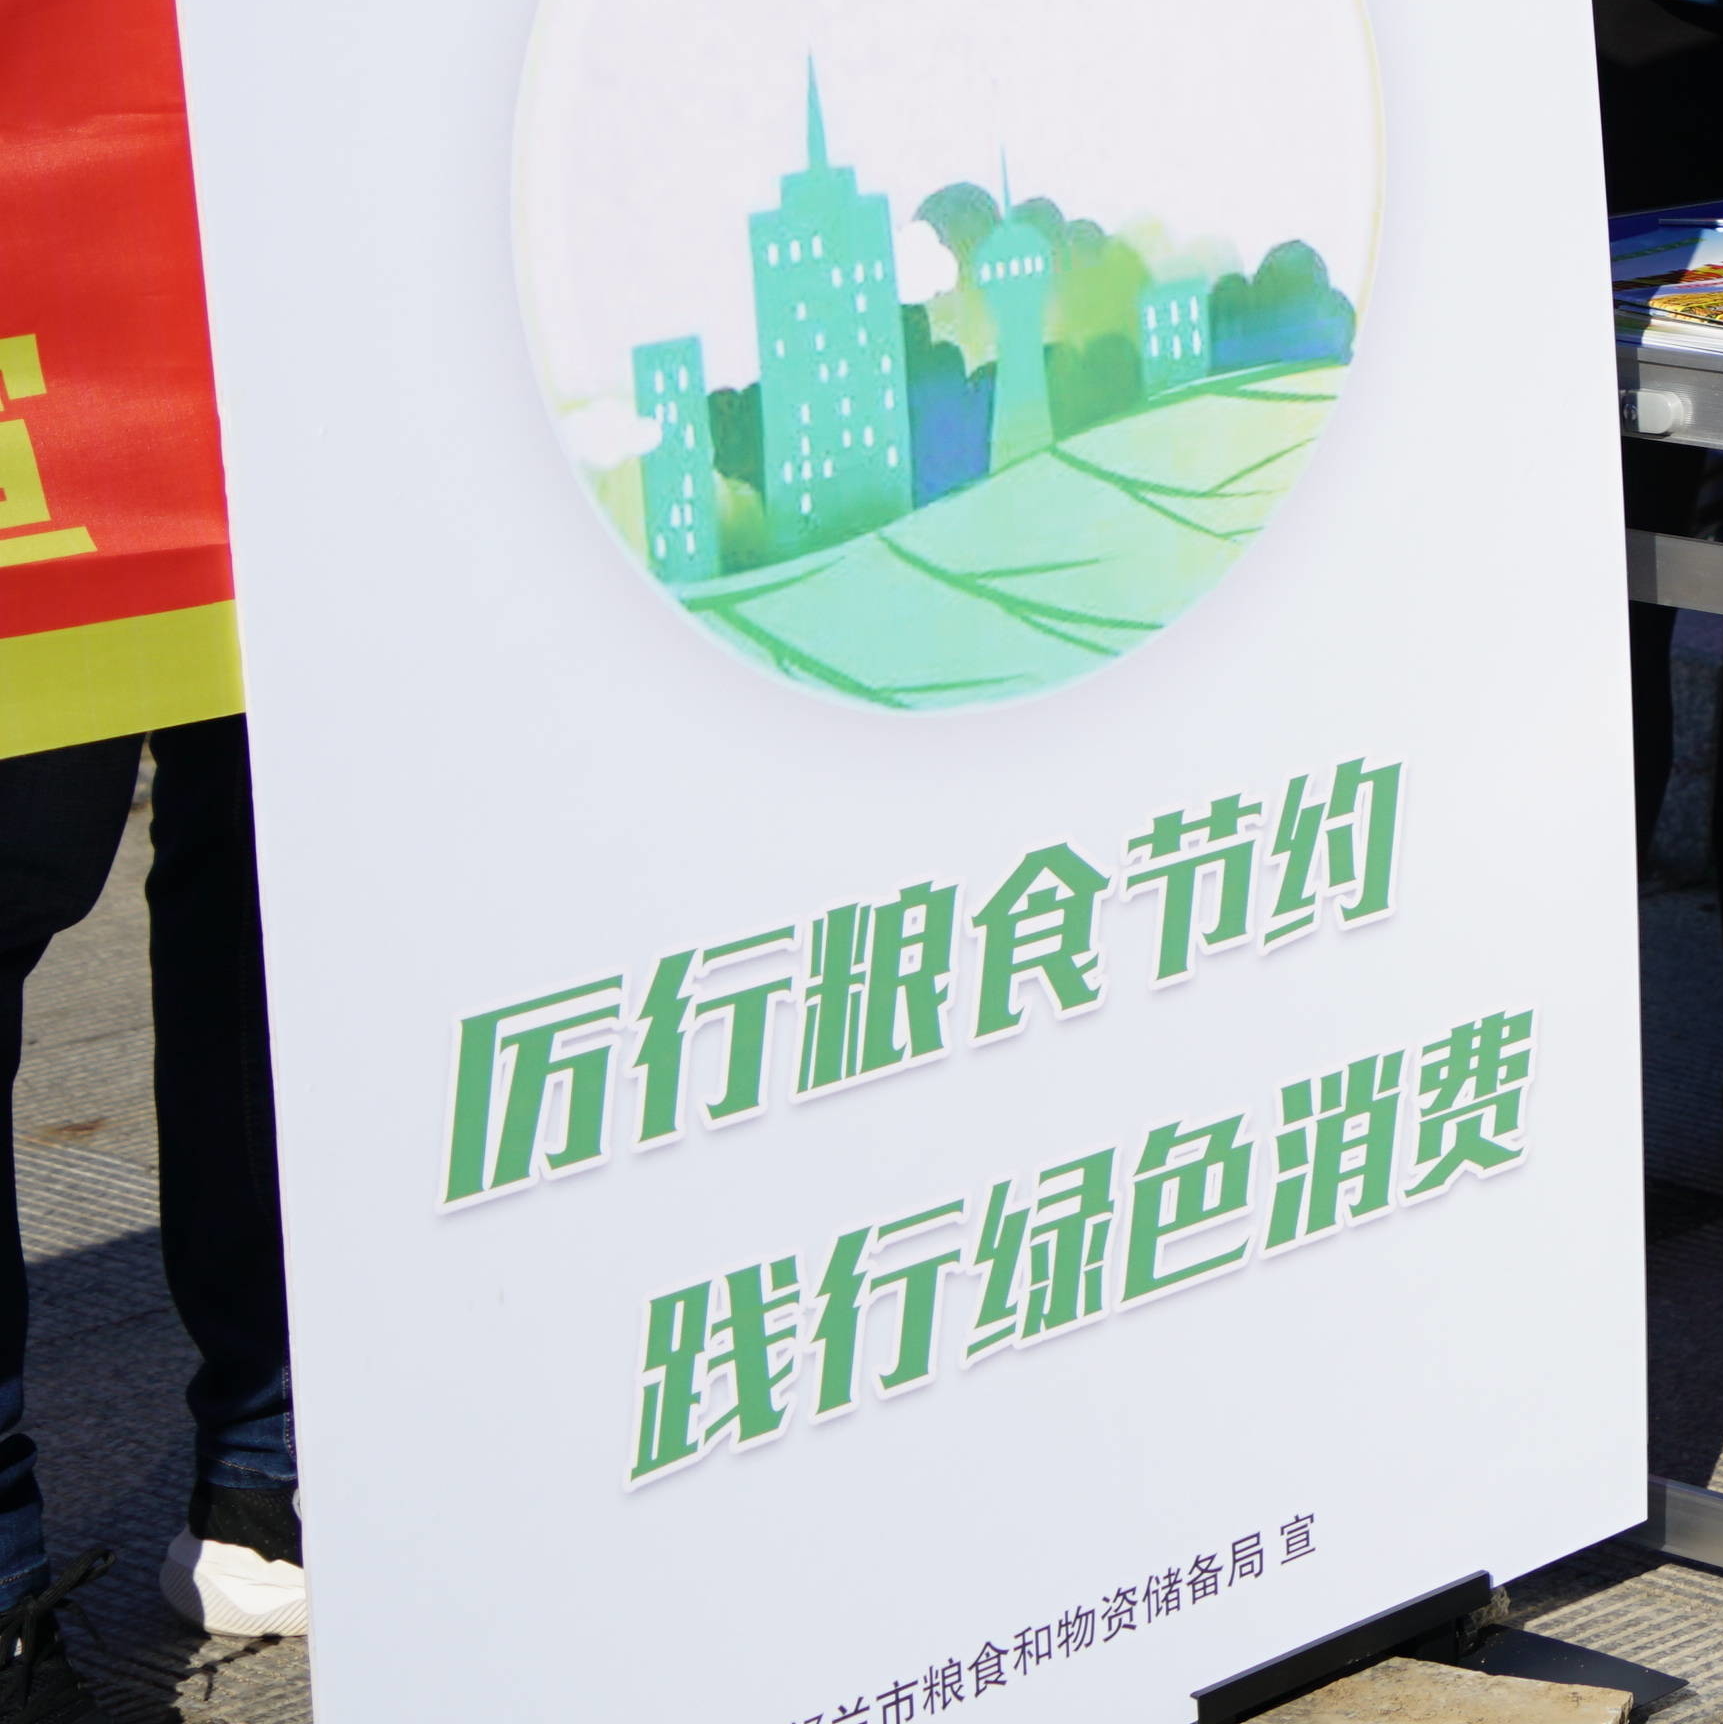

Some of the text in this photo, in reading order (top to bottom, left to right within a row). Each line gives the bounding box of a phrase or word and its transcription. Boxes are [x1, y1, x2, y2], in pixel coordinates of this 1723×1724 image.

[441, 756, 1403, 1206] 厉行粮食节约
[627, 1009, 1535, 1483] 践行绿色消费
[1279, 1512, 1318, 1566] 宣
